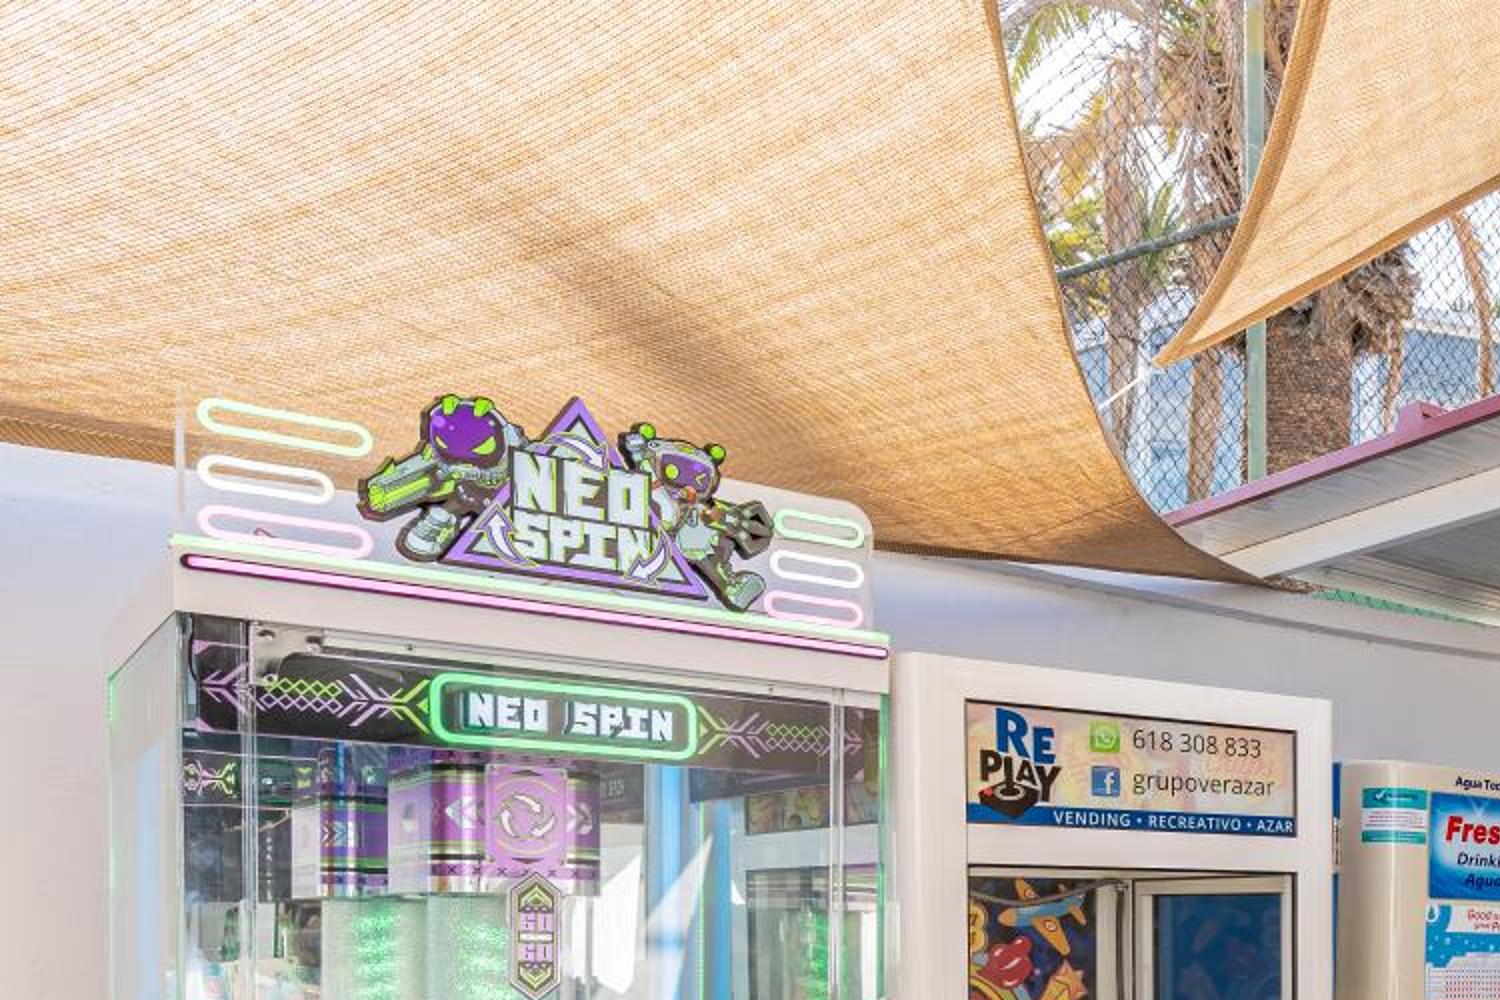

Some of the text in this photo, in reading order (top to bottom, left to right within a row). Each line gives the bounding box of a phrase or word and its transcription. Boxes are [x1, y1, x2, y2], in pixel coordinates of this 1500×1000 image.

[512, 446, 650, 530] NEO
[513, 513, 656, 573] SPIN
[467, 690, 674, 742] NEO SPIN
[995, 707, 1056, 766] RE
[1133, 729, 1262, 759] 618 308 833
[979, 748, 1062, 804] PLAY
[1133, 771, 1277, 798] grupoverazar
[1455, 776, 1483, 791] Agua
[1053, 809, 1294, 834] VENDING RECREATIVO AZAR
